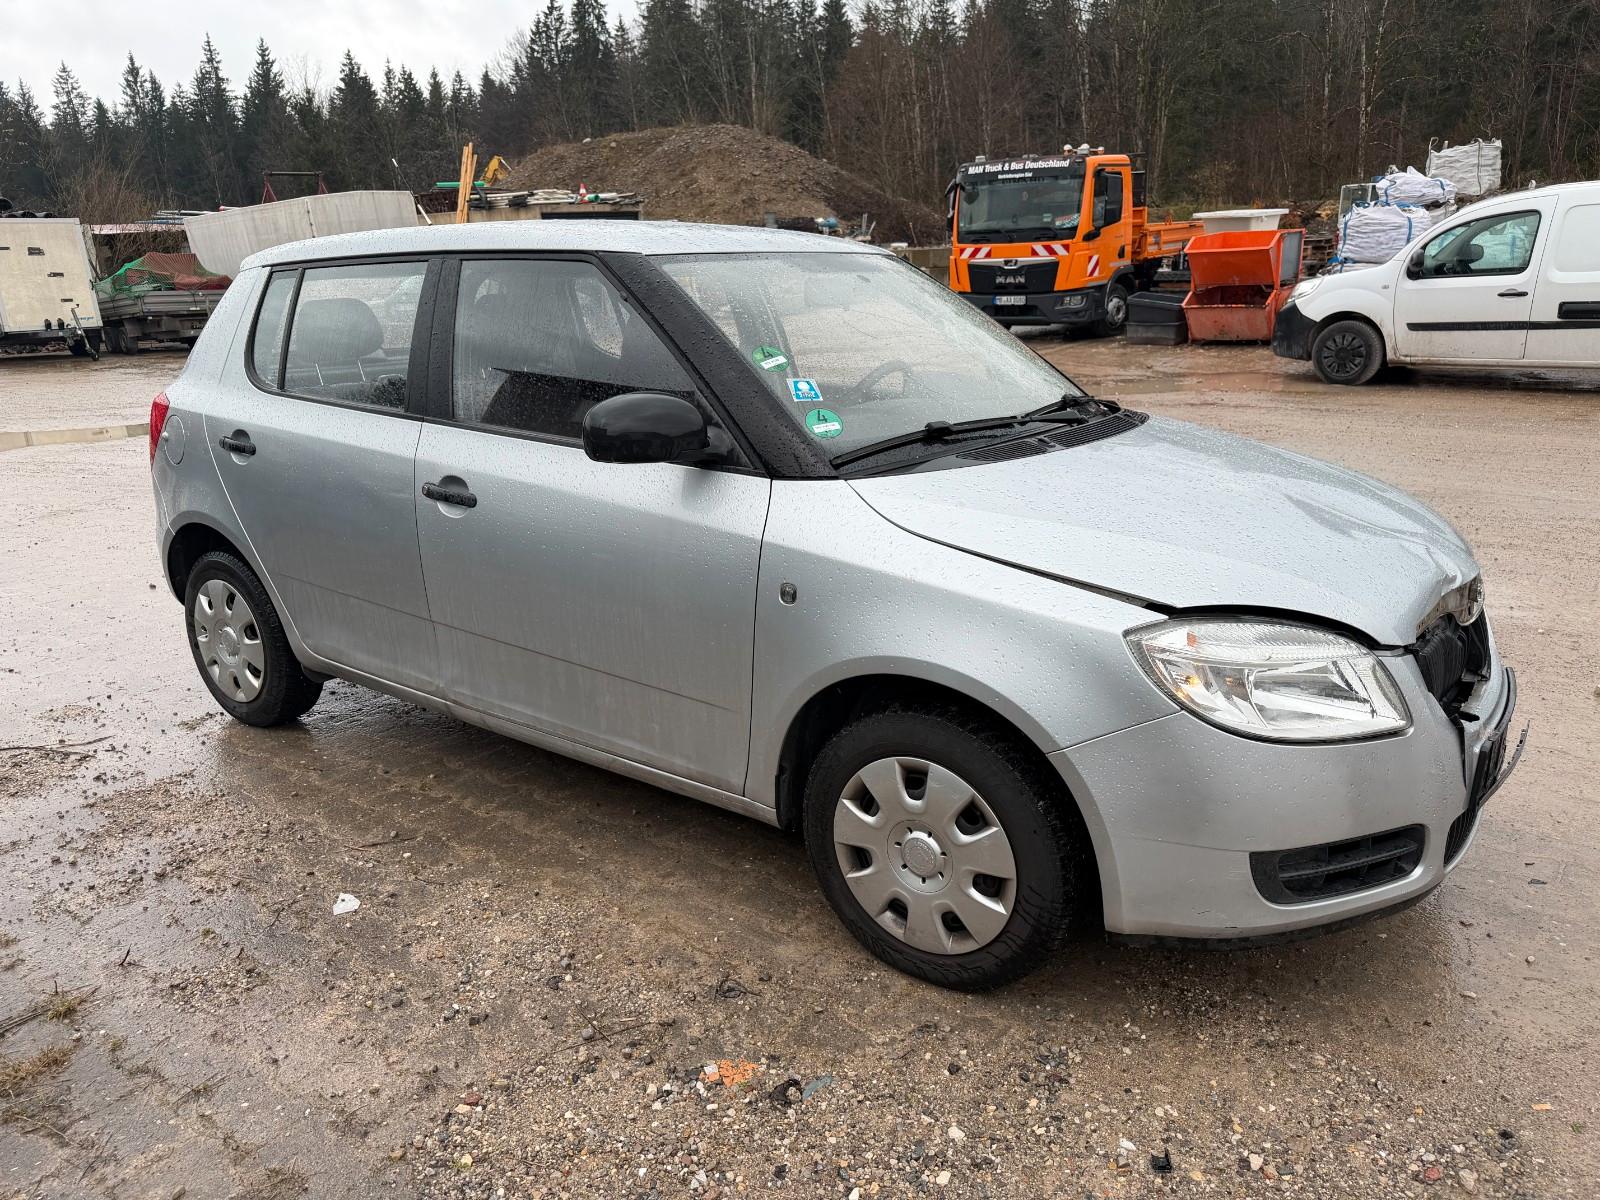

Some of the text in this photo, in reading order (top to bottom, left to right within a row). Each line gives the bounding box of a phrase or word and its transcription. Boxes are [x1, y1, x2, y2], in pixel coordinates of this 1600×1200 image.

[968, 159, 1070, 175] MAN Truck & Bus Deutschland
[995, 275, 1025, 284] MAN
[761, 347, 773, 358] 4
[817, 410, 828, 423] 4
